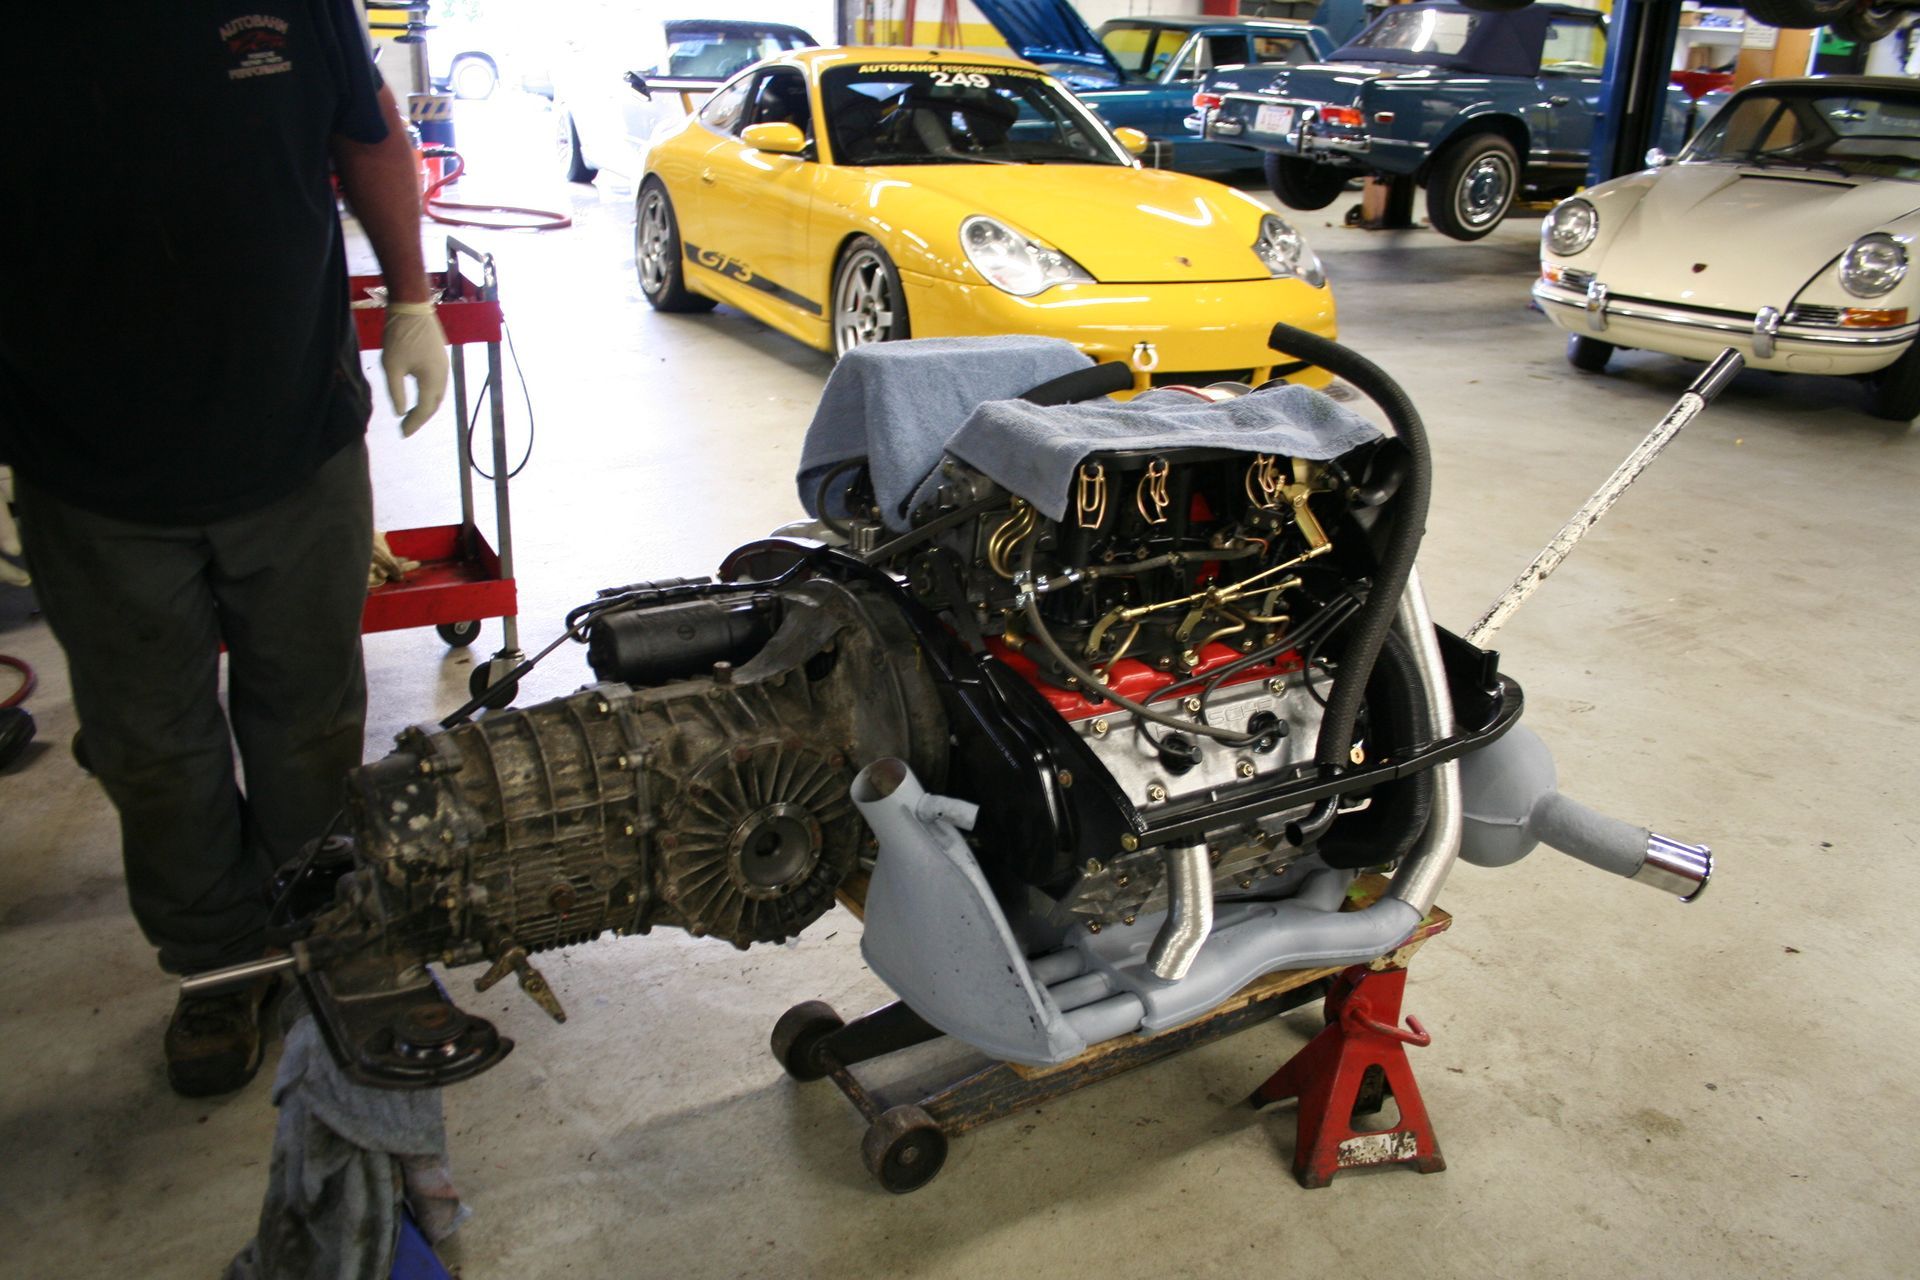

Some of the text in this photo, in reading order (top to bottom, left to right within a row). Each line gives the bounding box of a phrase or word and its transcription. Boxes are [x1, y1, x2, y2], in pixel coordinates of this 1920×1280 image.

[219, 14, 289, 41] AUTOBAHN
[859, 63, 939, 74] AUTOBAHN
[929, 71, 991, 89] 249
[697, 247, 753, 283] GT3
